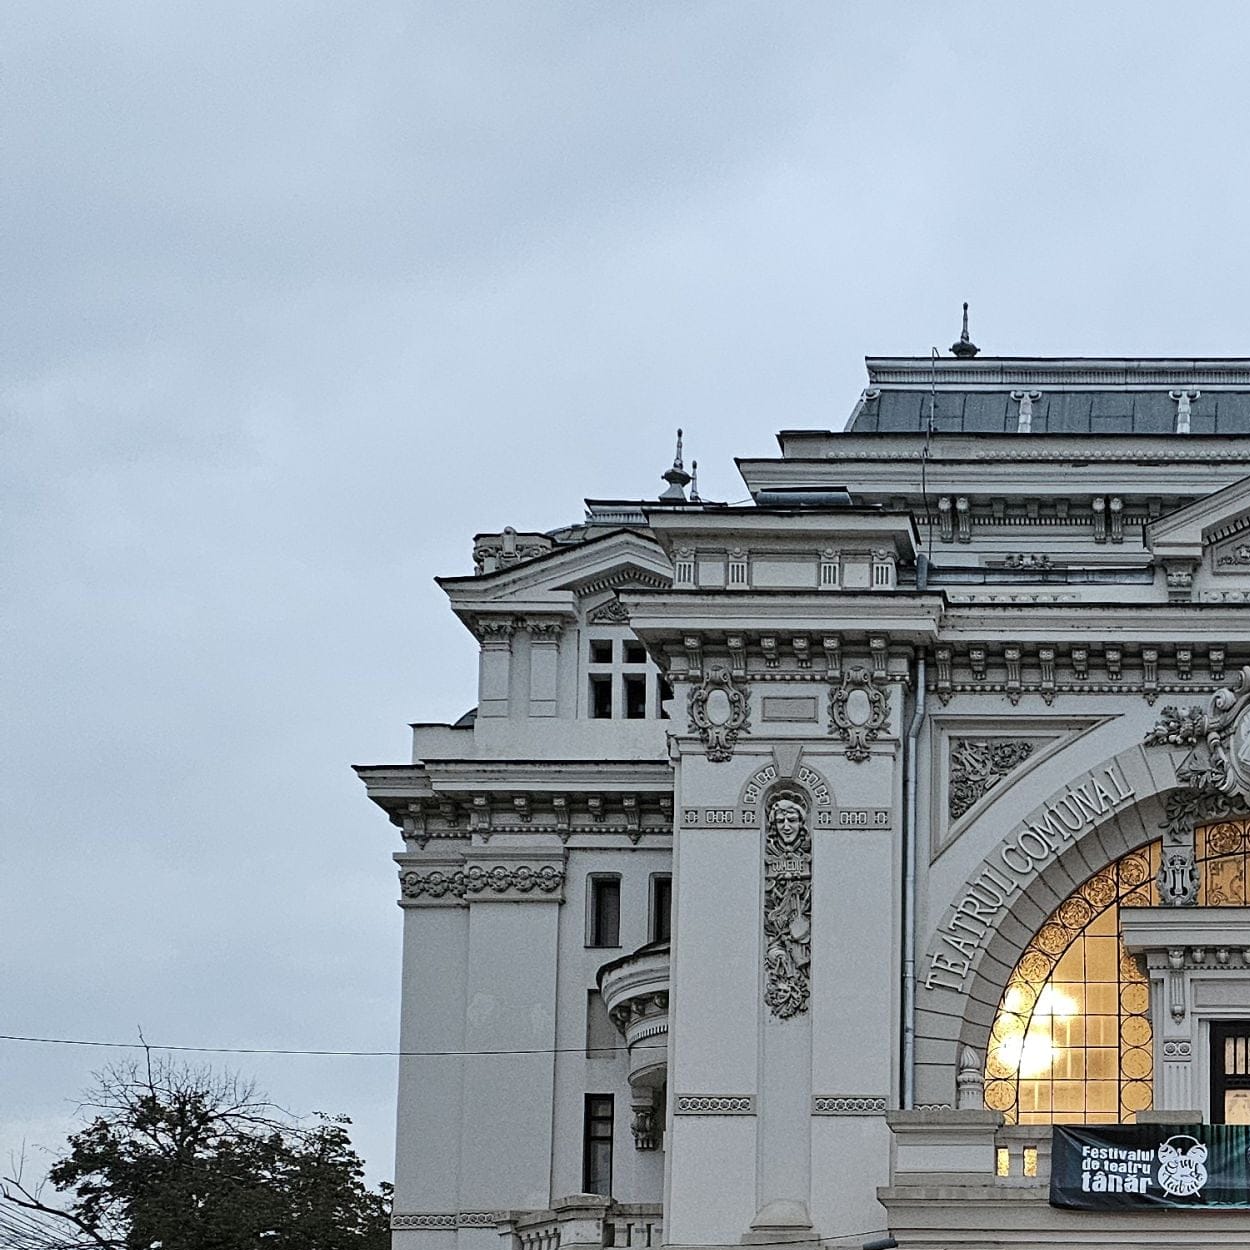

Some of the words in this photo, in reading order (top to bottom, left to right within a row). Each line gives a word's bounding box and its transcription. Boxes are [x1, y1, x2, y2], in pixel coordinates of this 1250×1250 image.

[925, 866, 1019, 993] TEATRUL
[1001, 766, 1136, 875] COMUNAL
[1082, 1145, 1155, 1162] Festivalul
[1082, 1158, 1100, 1170] de
[1104, 1160, 1151, 1175] teatru
[1081, 1170, 1153, 1194] tânăr
